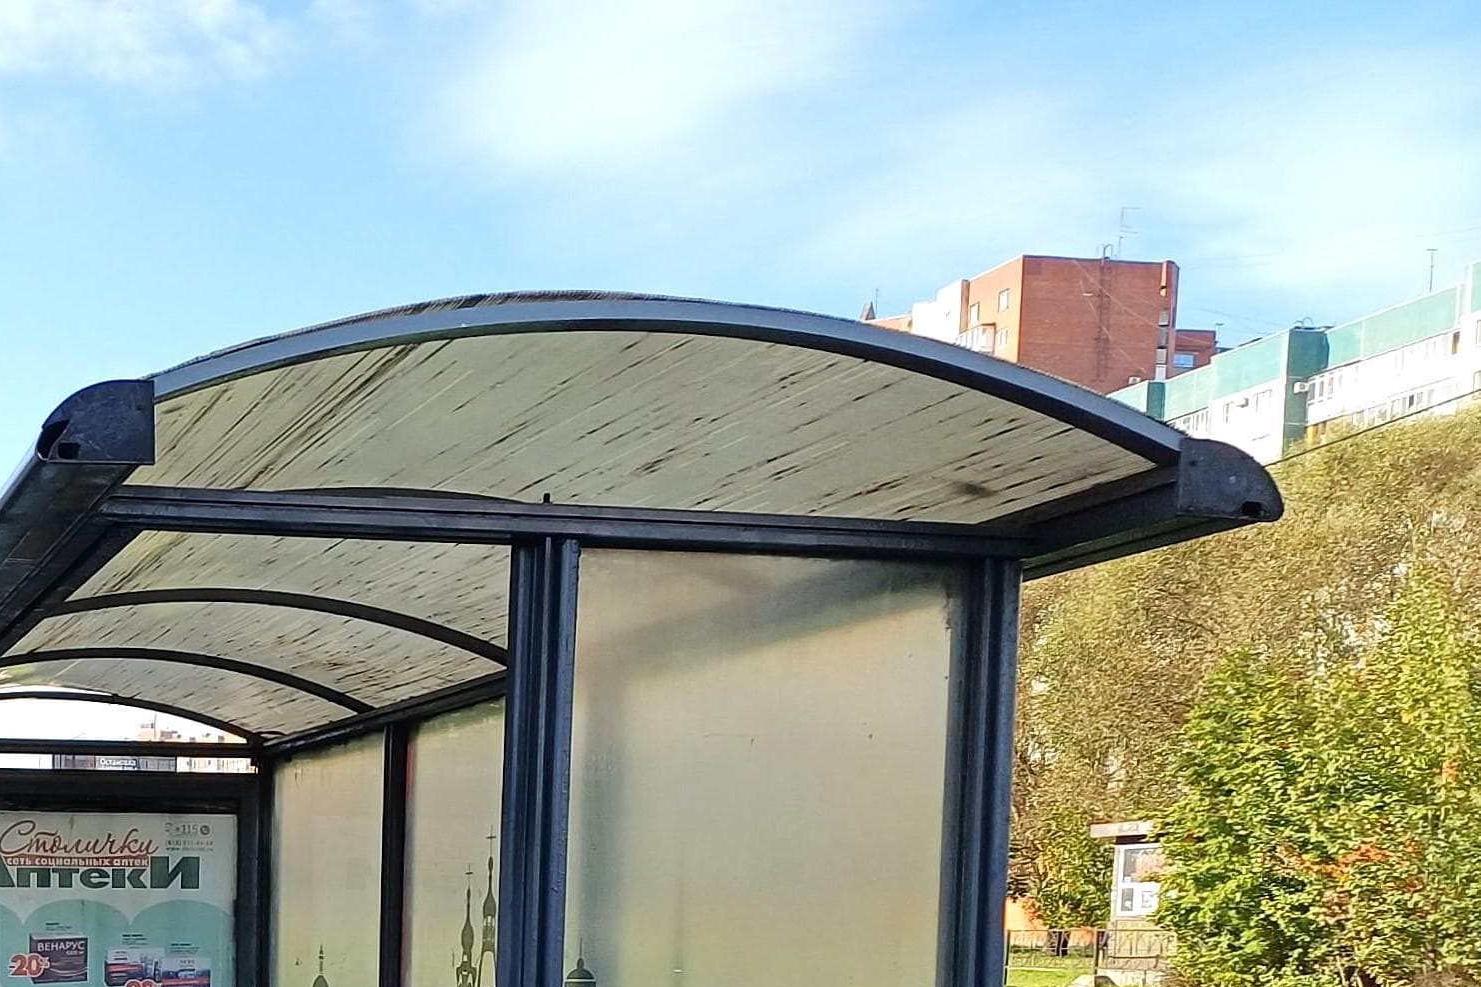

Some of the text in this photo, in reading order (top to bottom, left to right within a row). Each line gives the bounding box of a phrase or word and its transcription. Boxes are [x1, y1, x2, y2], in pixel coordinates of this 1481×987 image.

[6, 857, 149, 867] сеть социальных аптек
[37, 940, 86, 952] ВЕНАРУС
